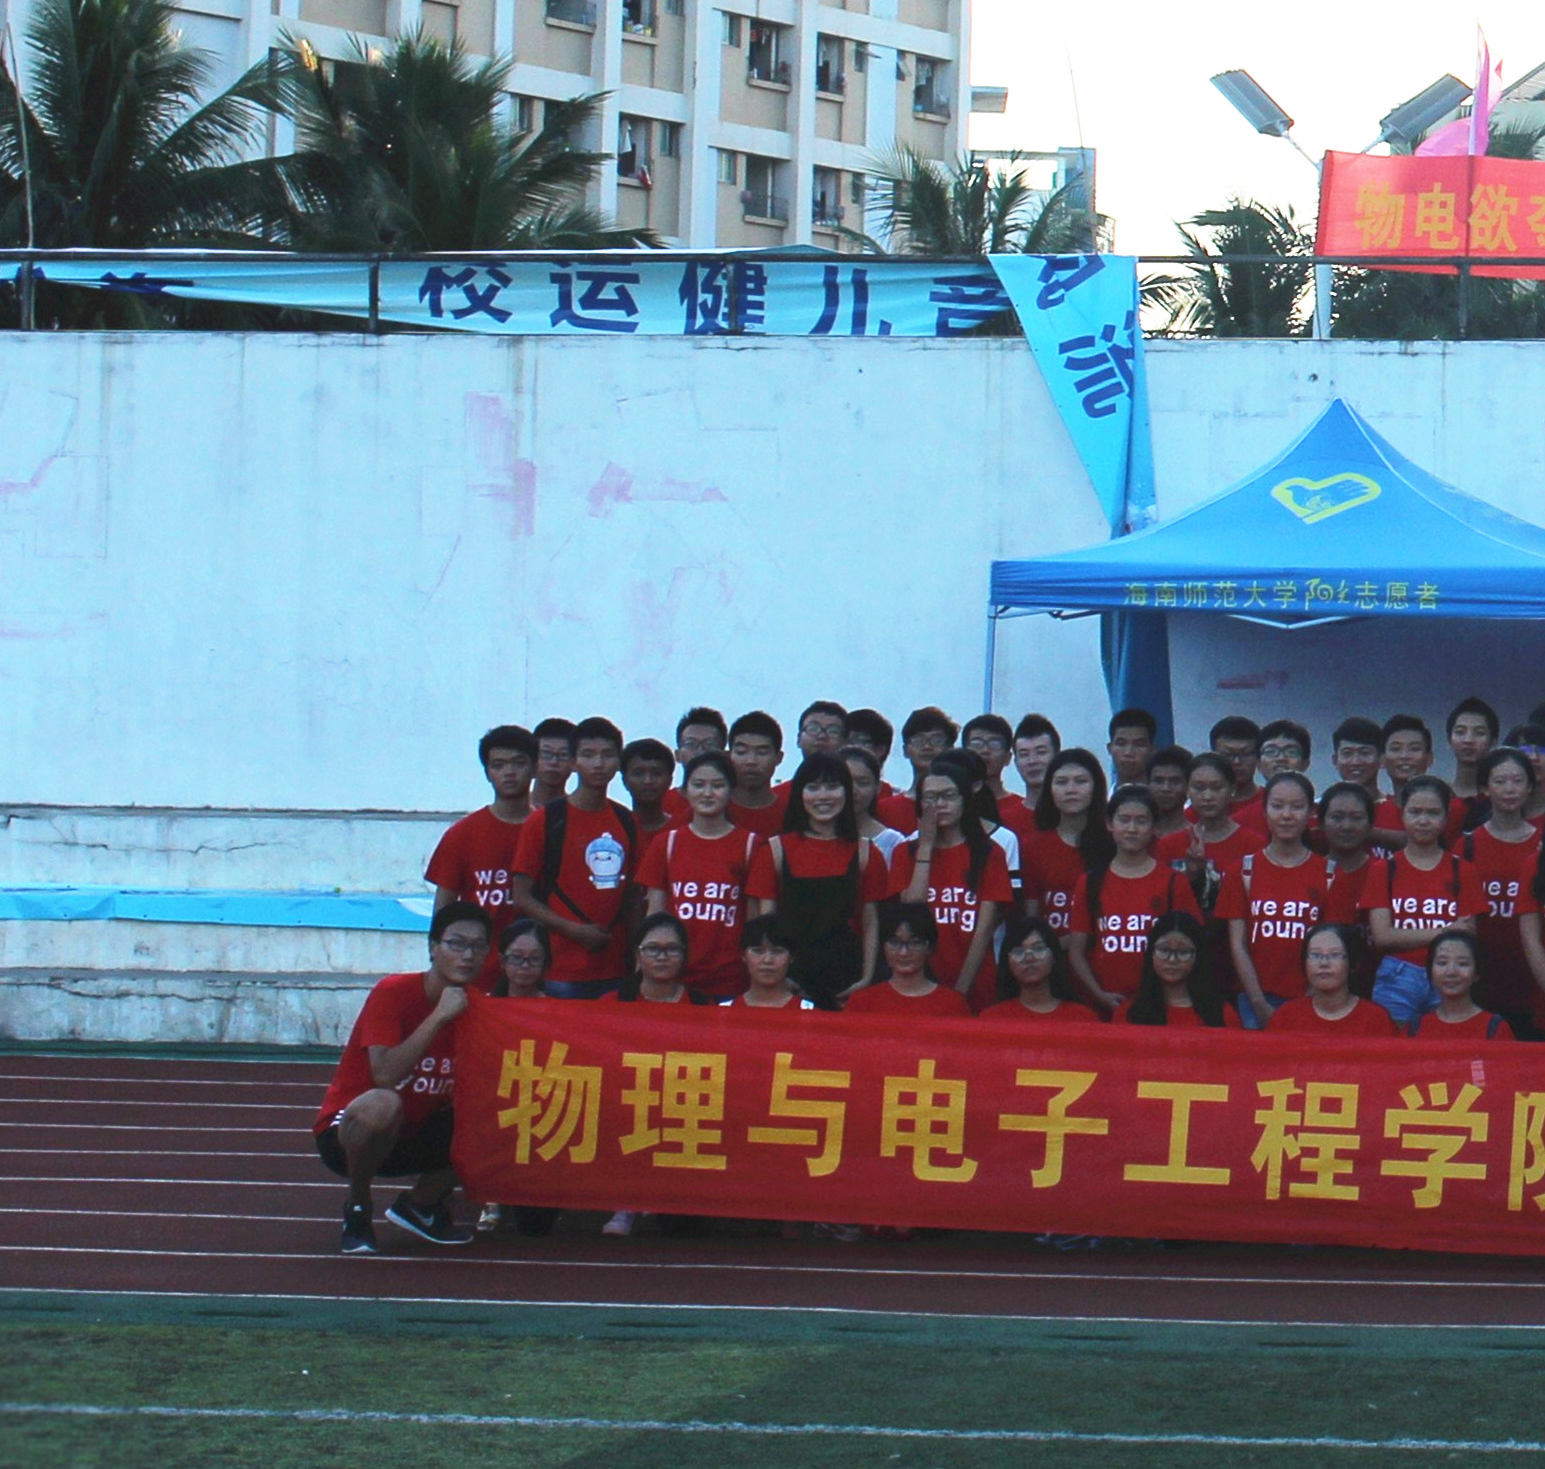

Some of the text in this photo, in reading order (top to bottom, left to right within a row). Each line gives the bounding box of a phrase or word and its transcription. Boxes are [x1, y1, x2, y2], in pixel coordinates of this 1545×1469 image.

[475, 869, 508, 885] we
[704, 882, 740, 899] are
[941, 887, 977, 905] are
[674, 901, 738, 927] oung
[1283, 899, 1319, 920] are
[1422, 898, 1457, 916] are
[934, 907, 976, 932] ung
[1102, 935, 1148, 953] oun
